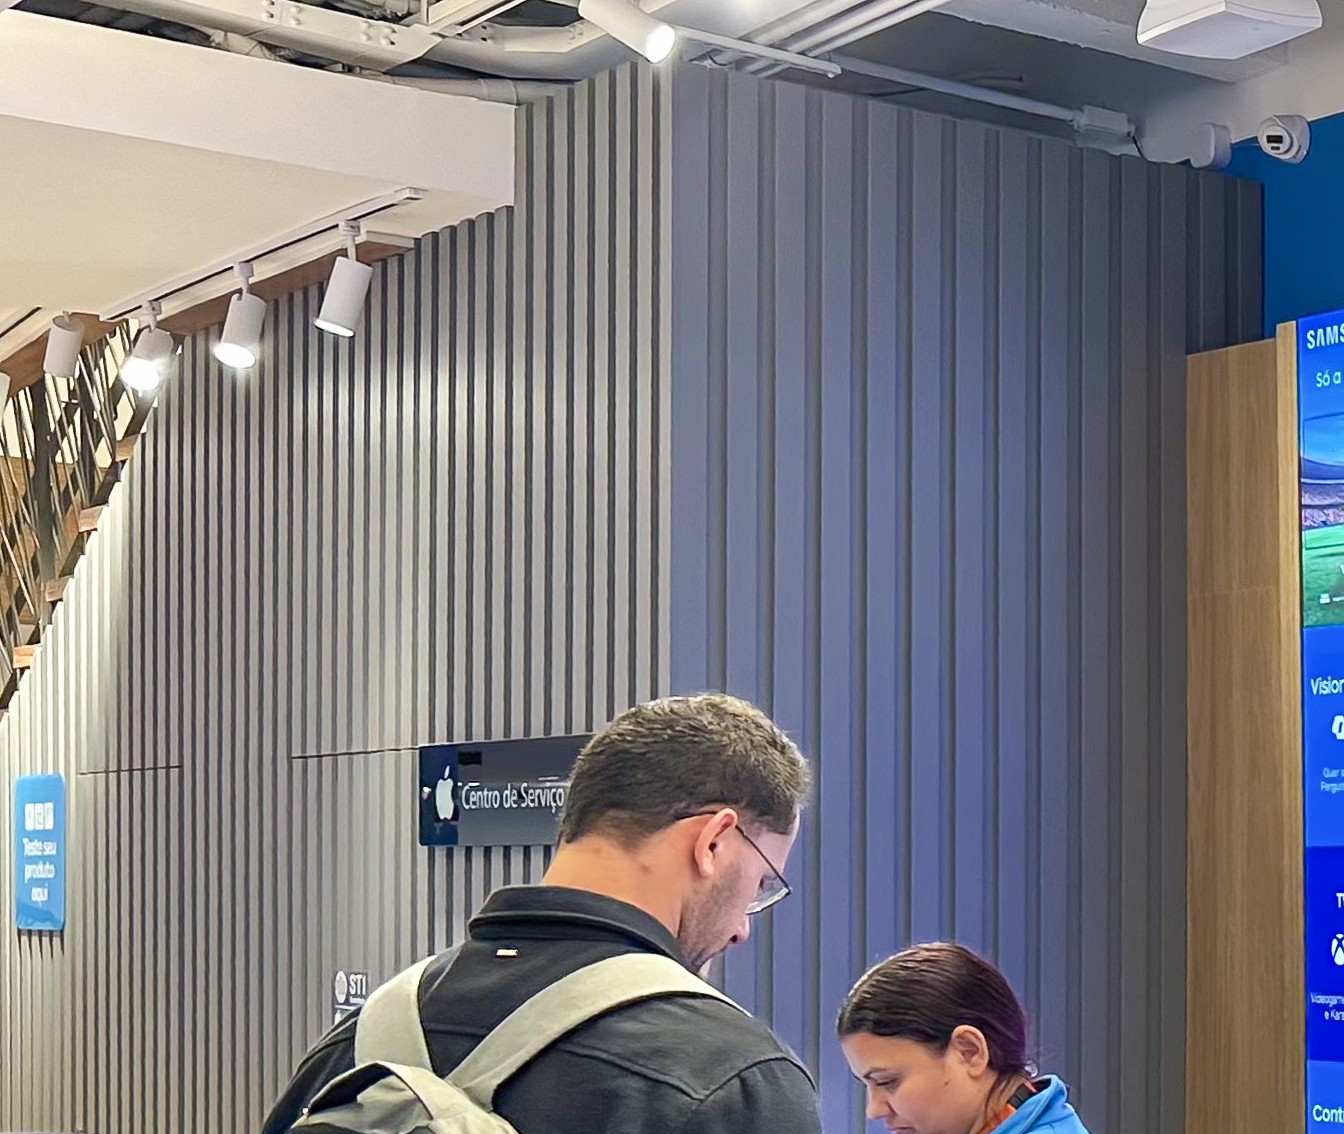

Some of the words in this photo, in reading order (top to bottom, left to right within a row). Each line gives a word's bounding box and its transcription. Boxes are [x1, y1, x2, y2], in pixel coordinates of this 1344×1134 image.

[1316, 368, 1331, 388] Só
[1334, 373, 1342, 385] a
[462, 785, 499, 809] Centro
[503, 783, 518, 808] de
[23, 838, 42, 856] Teste
